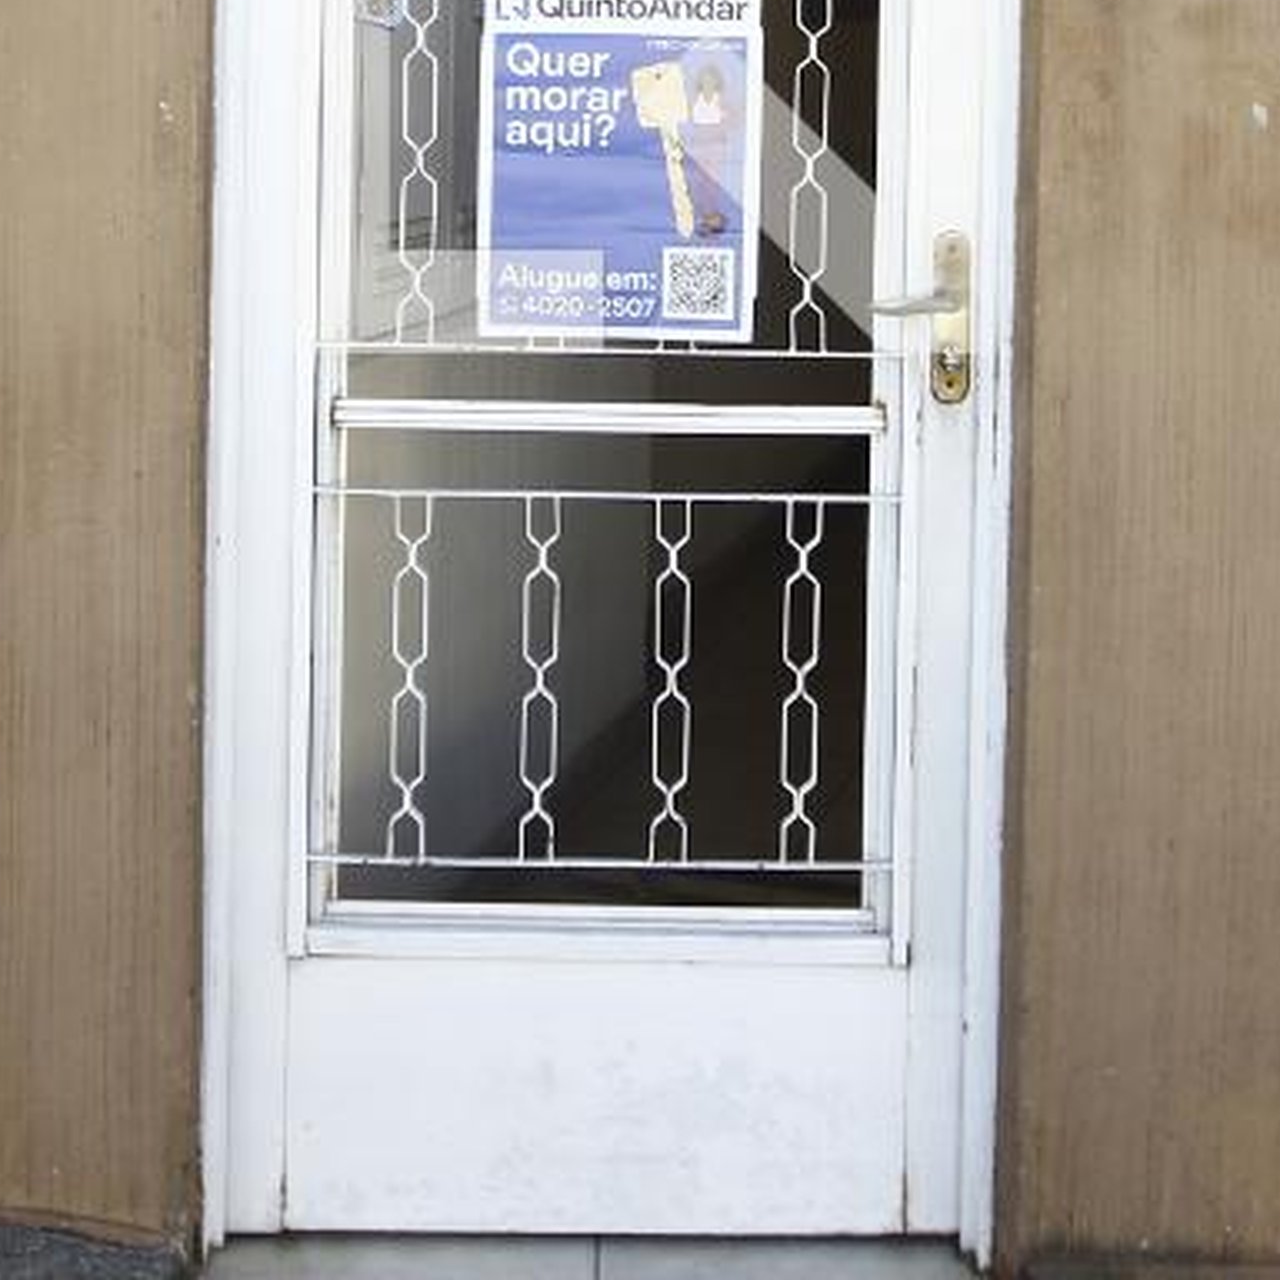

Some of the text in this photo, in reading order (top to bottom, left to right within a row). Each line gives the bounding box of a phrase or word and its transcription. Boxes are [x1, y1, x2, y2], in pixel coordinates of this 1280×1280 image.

[506, 42, 610, 80] Quer
[505, 84, 627, 113] morar
[505, 116, 617, 154] aqui?
[497, 263, 658, 294] Alugue em:
